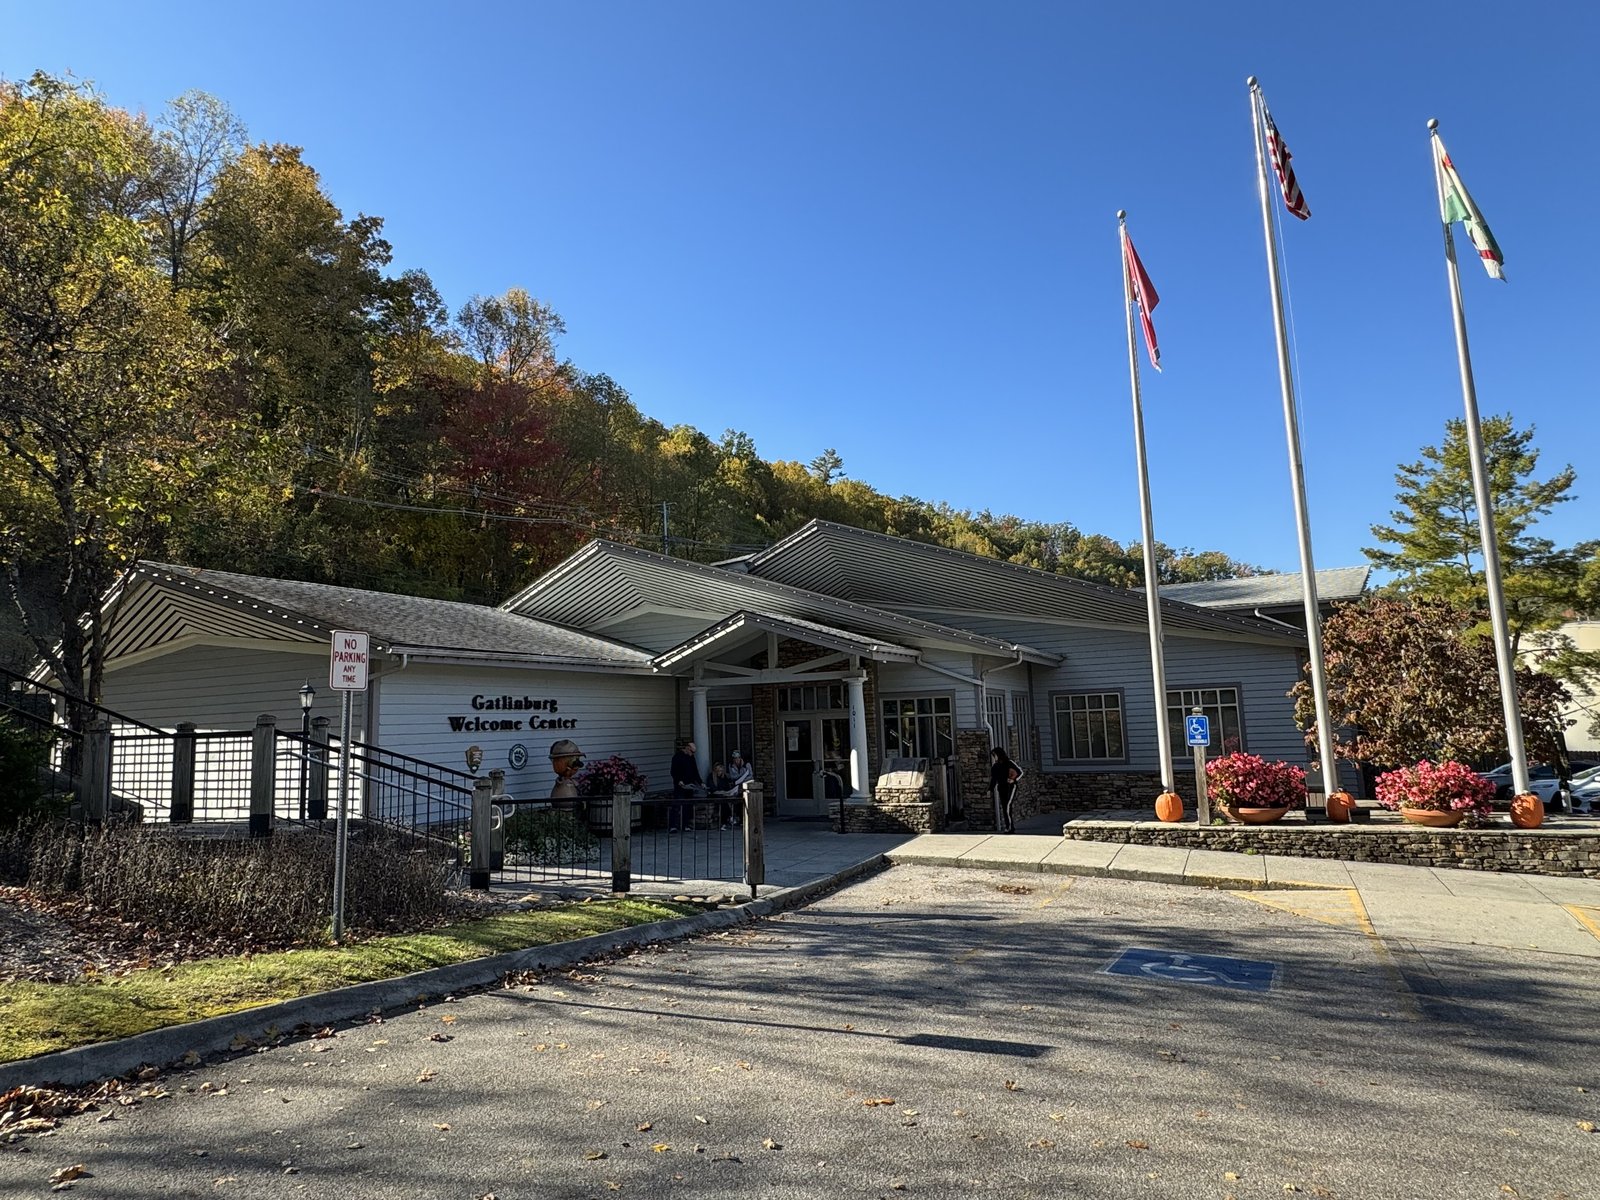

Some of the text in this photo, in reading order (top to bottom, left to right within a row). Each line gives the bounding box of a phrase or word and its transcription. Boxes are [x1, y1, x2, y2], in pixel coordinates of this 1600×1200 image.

[344, 638, 357, 650] NO
[334, 651, 366, 664] PARKING
[343, 665, 356, 673] ANY
[342, 675, 356, 683] TIME
[471, 694, 558, 713] Gatlinburg
[448, 715, 578, 732] Welcome Center
